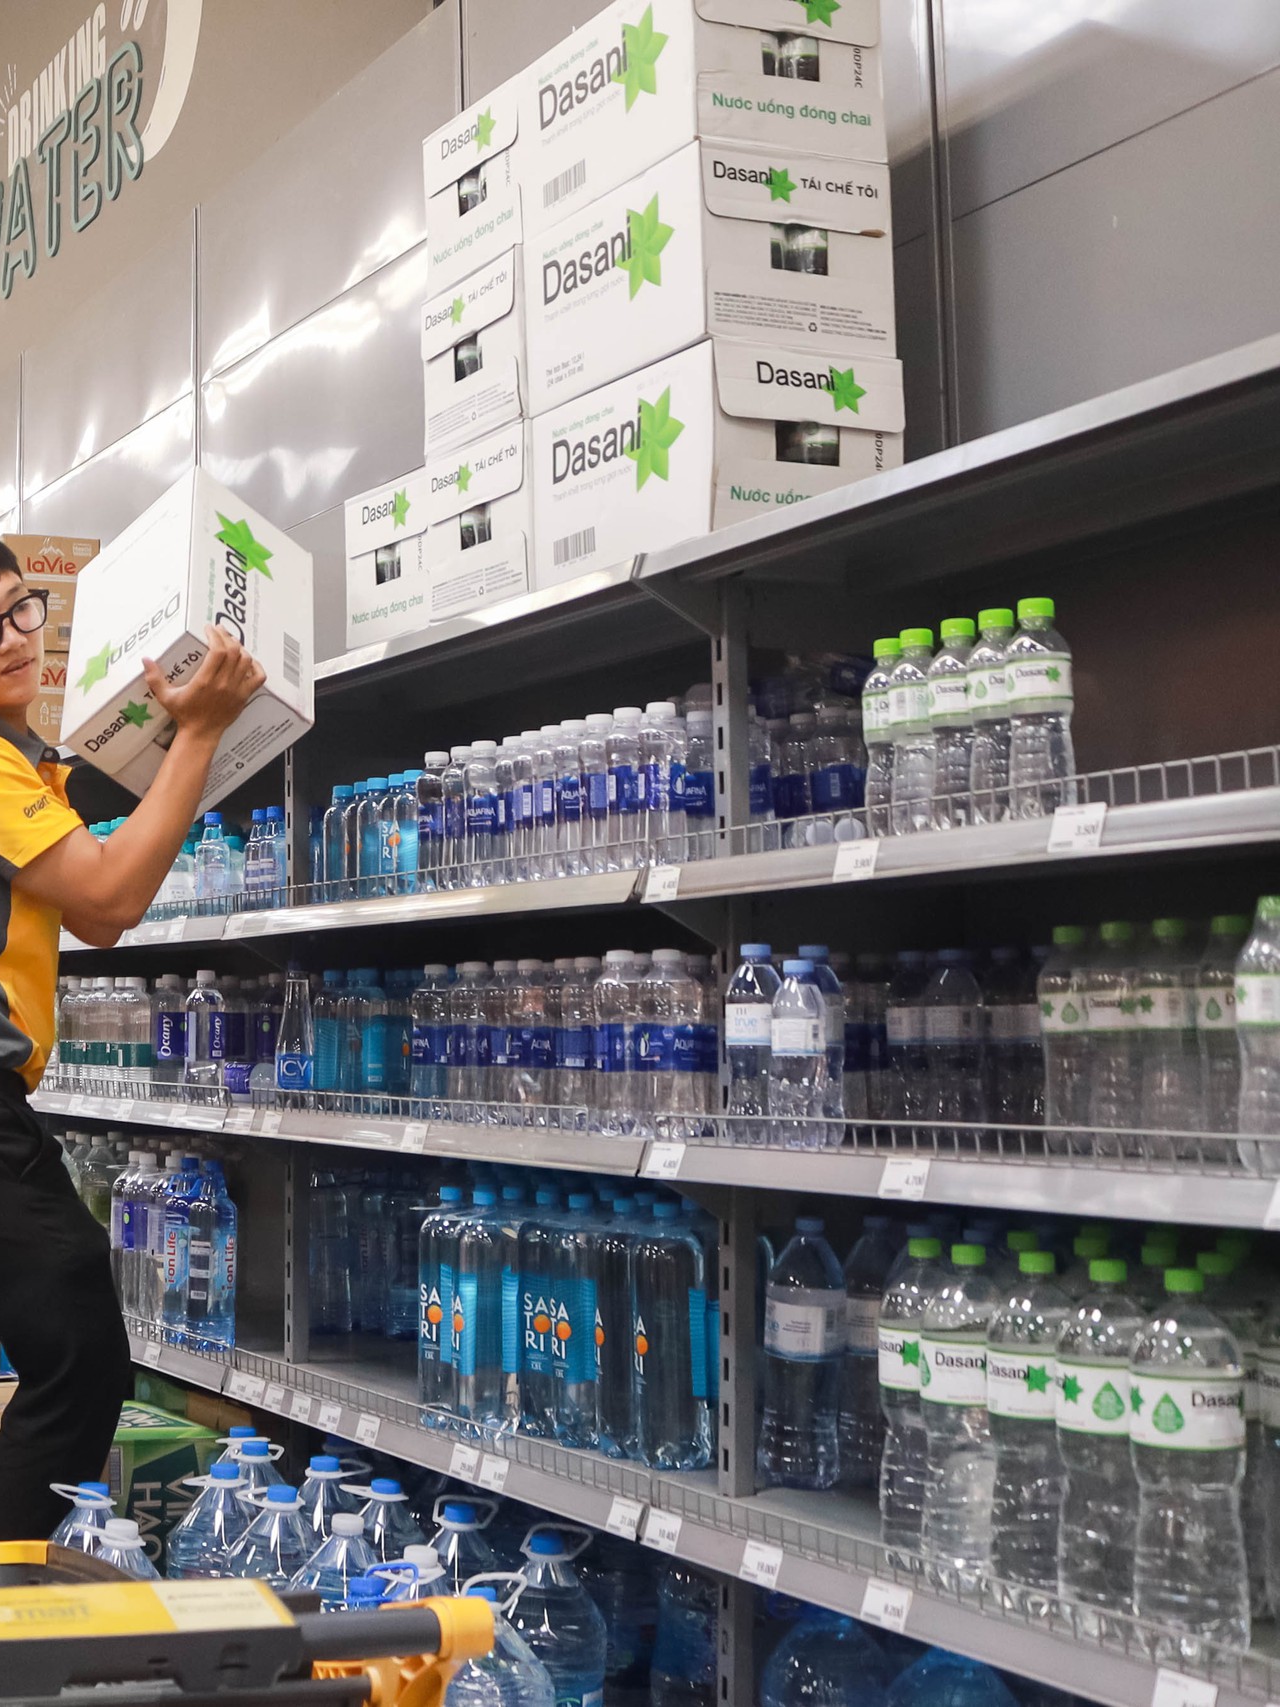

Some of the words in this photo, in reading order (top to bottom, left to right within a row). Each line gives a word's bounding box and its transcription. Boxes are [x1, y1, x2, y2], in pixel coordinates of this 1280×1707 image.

[8, 3, 106, 177] DRINKING
[539, 29, 628, 131] Dasani
[712, 92, 753, 110] Nước
[758, 97, 795, 119] uống
[800, 105, 837, 125] đóng
[841, 111, 872, 126] chai
[441, 121, 481, 161] Dasani
[713, 161, 773, 186] Dasani
[800, 177, 822, 191] TÁI
[825, 180, 853, 196] CHẾ
[857, 184, 878, 199] TÔI
[543, 215, 632, 306] Dasani
[756, 361, 836, 392] Dasani
[553, 404, 642, 484] Dasani
[431, 468, 462, 493] Dasani
[362, 493, 398, 525] Dasani
[730, 485, 770, 504] Nước
[775, 487, 813, 505] uốn
[26, 555, 77, 575] laVie
[215, 538, 248, 647] Dasani
[105, 591, 181, 677] Dasani
[182, 650, 203, 667] TÔI
[84, 708, 134, 753] Dasani
[160, 1015, 174, 1057] Ocany
[213, 1016, 222, 1049] Ocany
[280, 1060, 308, 1077] ICY
[166, 1231, 176, 1256] Life
[224, 1236, 235, 1262] Life
[420, 1283, 442, 1305] SA
[523, 1292, 549, 1314] SA
[550, 1297, 570, 1321] SA
[421, 1319, 437, 1341] RI
[525, 1329, 546, 1352] RI
[551, 1336, 567, 1360] RI
[935, 1351, 987, 1369] Dasani
